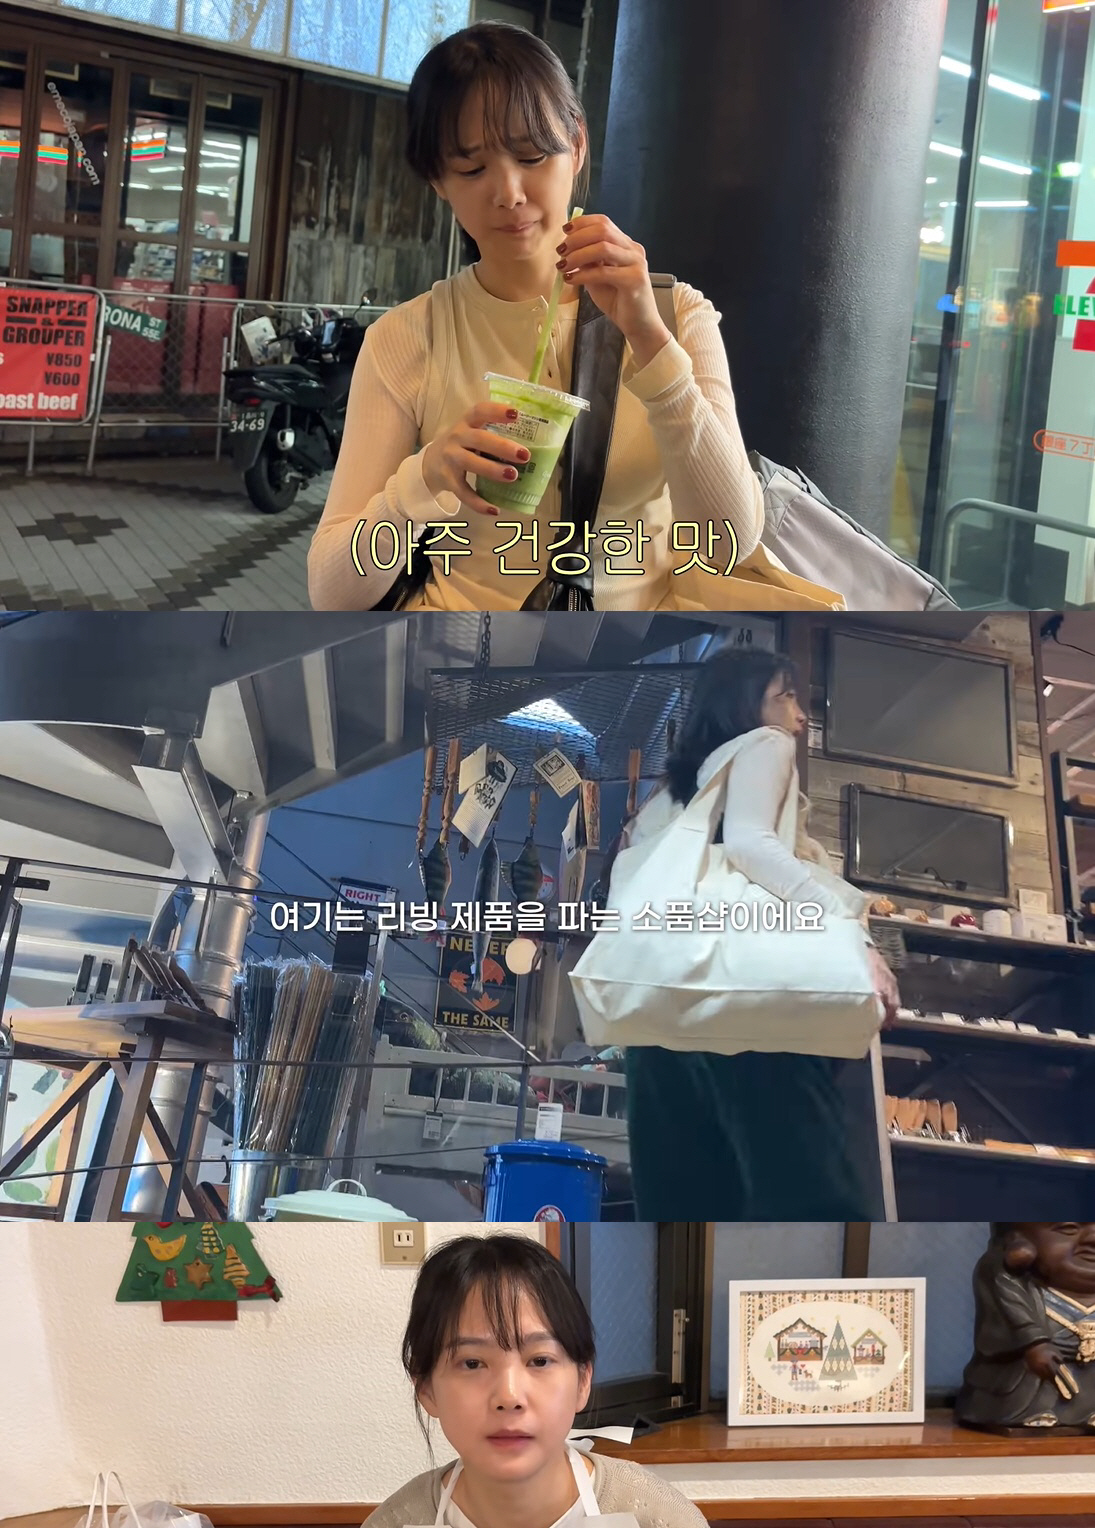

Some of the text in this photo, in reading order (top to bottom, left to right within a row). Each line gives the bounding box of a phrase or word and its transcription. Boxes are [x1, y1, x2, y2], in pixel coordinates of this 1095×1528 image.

[6, 296, 88, 316] SNAPPER
[149, 317, 161, 328] ST
[3, 326, 86, 346] GROUPER
[46, 352, 82, 367] ¥850
[44, 371, 80, 386] ¥600
[37, 392, 79, 410] beef
[345, 889, 381, 901] RIGHT
[449, 936, 510, 956] NEER
[443, 1011, 509, 1027] THE SAME
